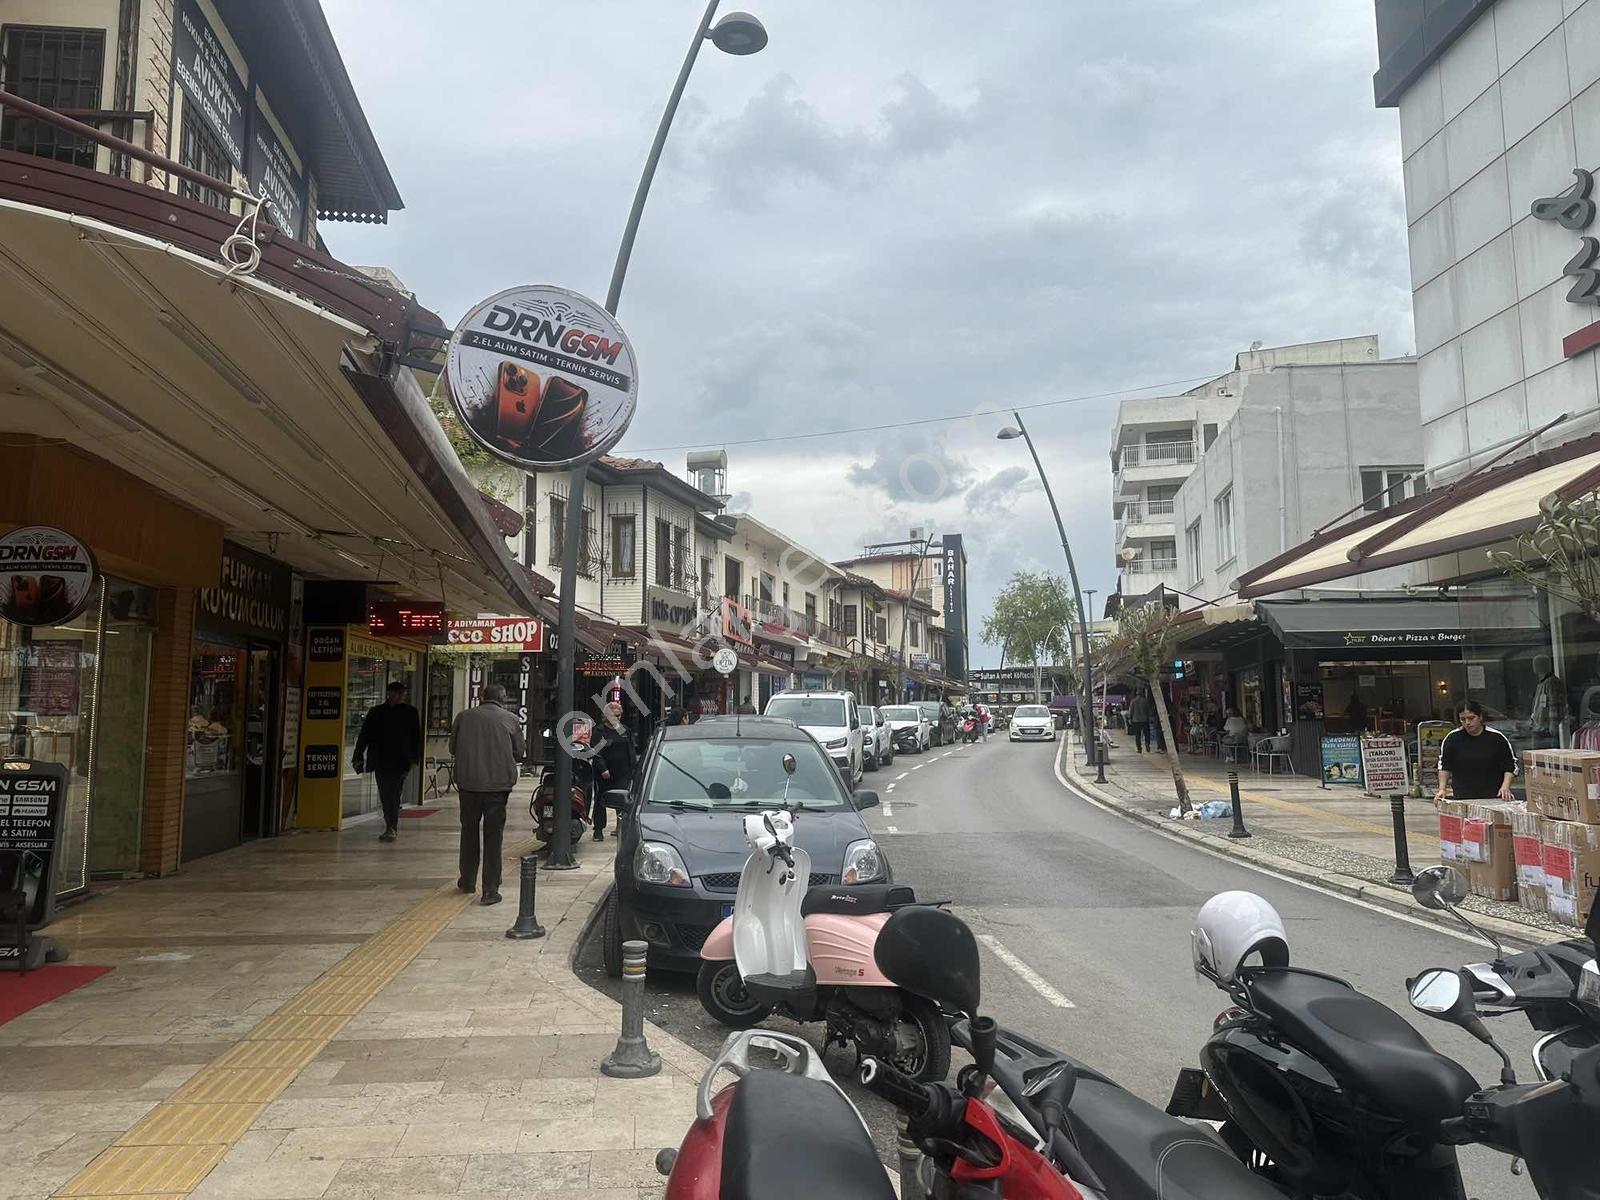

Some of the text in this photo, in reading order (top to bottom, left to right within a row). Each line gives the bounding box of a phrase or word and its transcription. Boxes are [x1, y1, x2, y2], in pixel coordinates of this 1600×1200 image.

[182, 10, 205, 54] HUKUK
[176, 56, 204, 105] EGEMEN
[192, 52, 233, 126] AVUKAT
[264, 165, 294, 220] AVUKAT
[472, 335, 494, 347] 2.EL
[494, 339, 518, 354] ALIM
[518, 347, 549, 363] SATIM
[555, 357, 588, 374] TEKNİK
[589, 368, 621, 386] SERVİS
[947, 549, 956, 586] BAHAR
[200, 586, 284, 632] KUYUMCULUK
[454, 619, 496, 628] ADIYAMAN
[490, 620, 538, 643] SHOP
[1370, 633, 1396, 644] Döner
[1405, 633, 1429, 643] Pizza
[980, 671, 996, 680] Sultan
[996, 671, 1013, 680] Amet
[305, 752, 337, 762] TEKNİK
[305, 762, 335, 771] SERVİS
[14, 779, 57, 792] GSM
[15, 796, 47, 804] SAMSUNG
[13, 819, 51, 828] TELEFON
[1, 829, 37, 837] & SATIM
[15, 841, 48, 849] AKSESUAR
